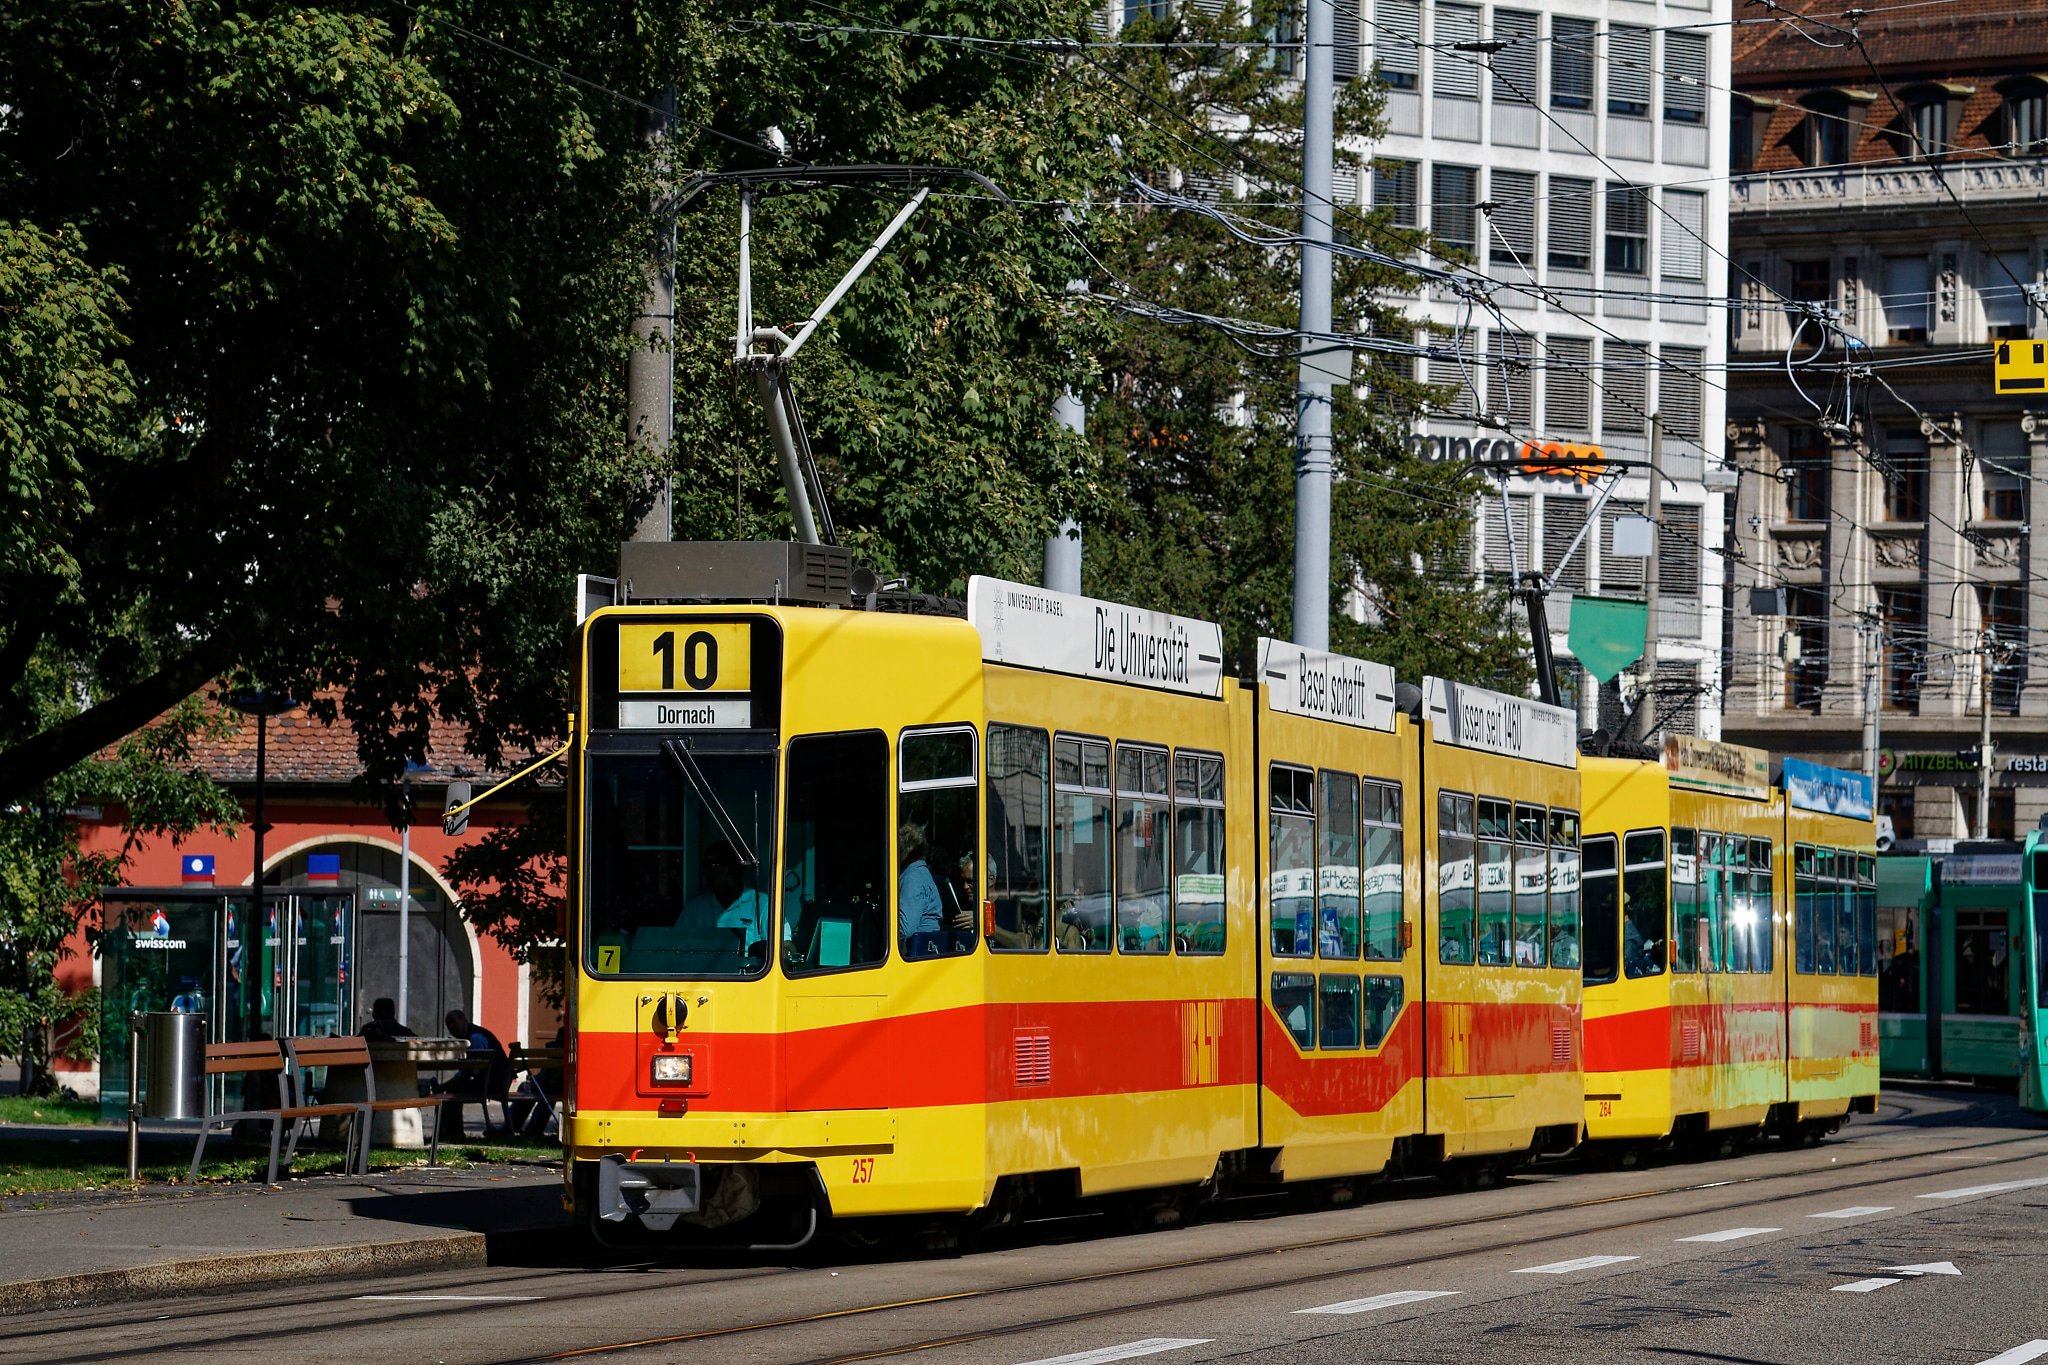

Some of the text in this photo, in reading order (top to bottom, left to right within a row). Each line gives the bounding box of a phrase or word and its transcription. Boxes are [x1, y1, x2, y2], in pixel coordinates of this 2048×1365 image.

[1007, 591, 1063, 617] UNIVERSITÄT BASEL
[1095, 606, 1189, 685] Die Universität
[653, 630, 719, 690] 10
[1300, 652, 1365, 720] Basel schafft
[657, 704, 715, 724] Dornach
[1452, 686, 1522, 752] Wissen seit 1460
[2008, 755, 2047, 771] resta
[135, 937, 187, 949] swisscom
[604, 950, 614, 966] 7
[1181, 1002, 1223, 1086] BLT
[1600, 1101, 1611, 1117] 264
[853, 1157, 874, 1184] 257
